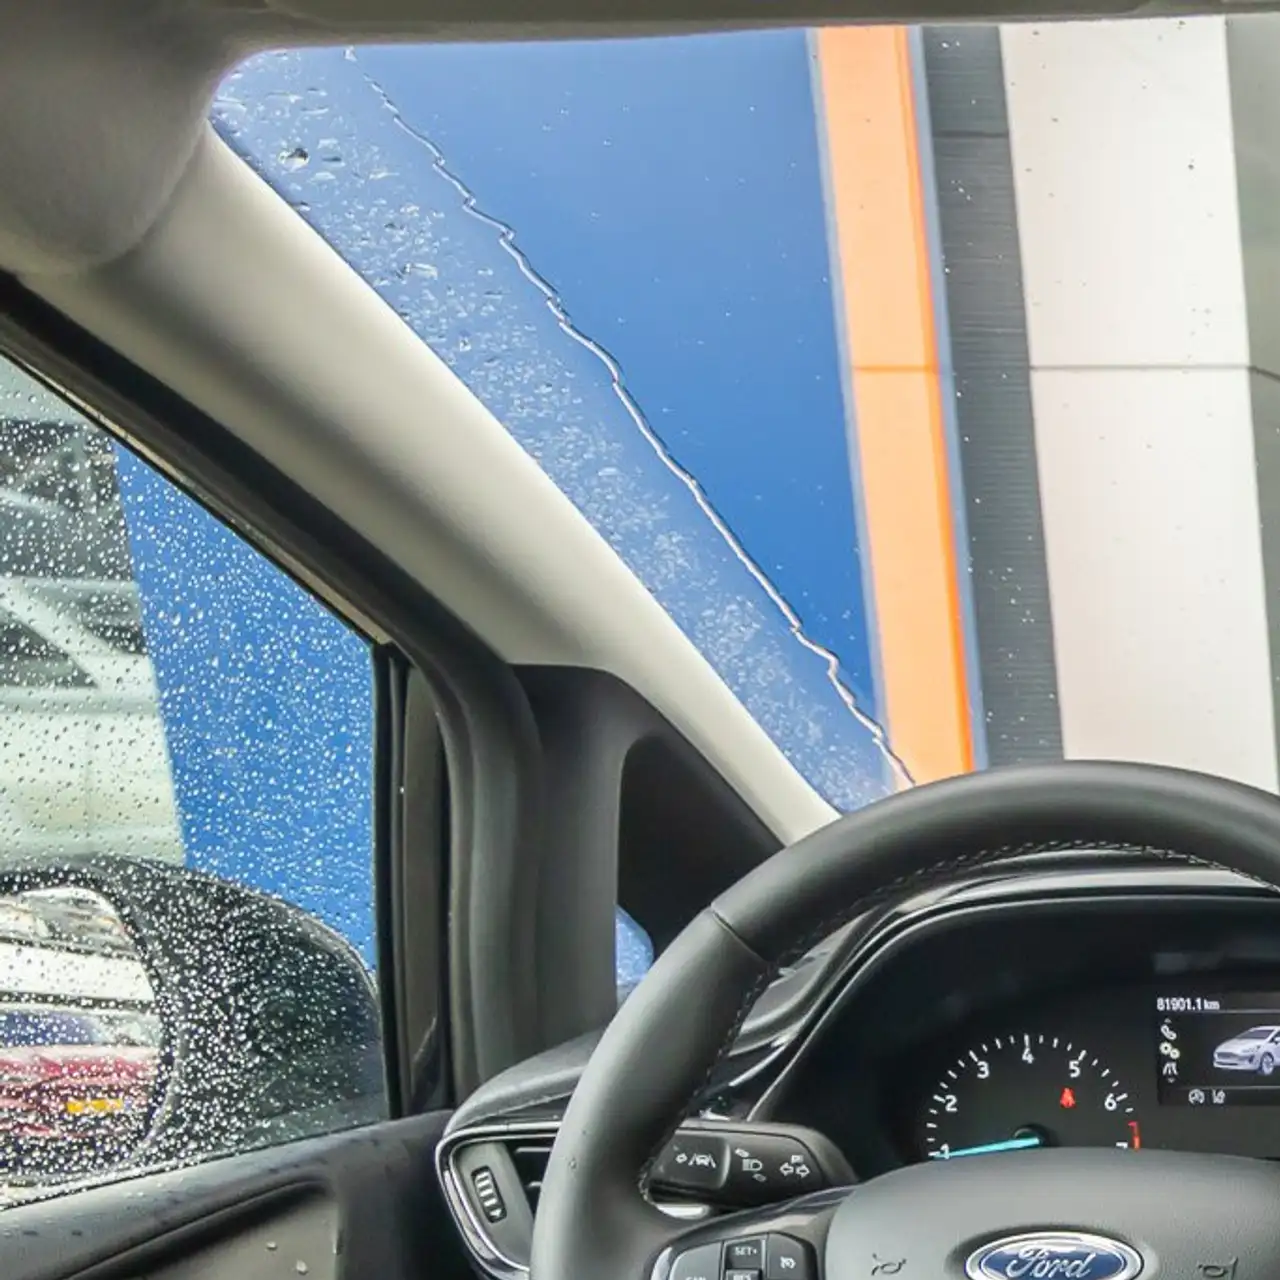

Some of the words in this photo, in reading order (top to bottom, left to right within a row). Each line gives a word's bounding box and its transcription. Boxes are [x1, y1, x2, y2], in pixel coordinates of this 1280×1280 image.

[1203, 998, 1221, 1011] km
[1021, 1048, 1035, 1064] 4
[976, 1060, 990, 1079] 3
[1068, 1060, 1081, 1078] 5
[945, 1094, 958, 1112] 2
[1104, 1092, 1117, 1111] 6
[1005, 1247, 1096, 1279] Ford
